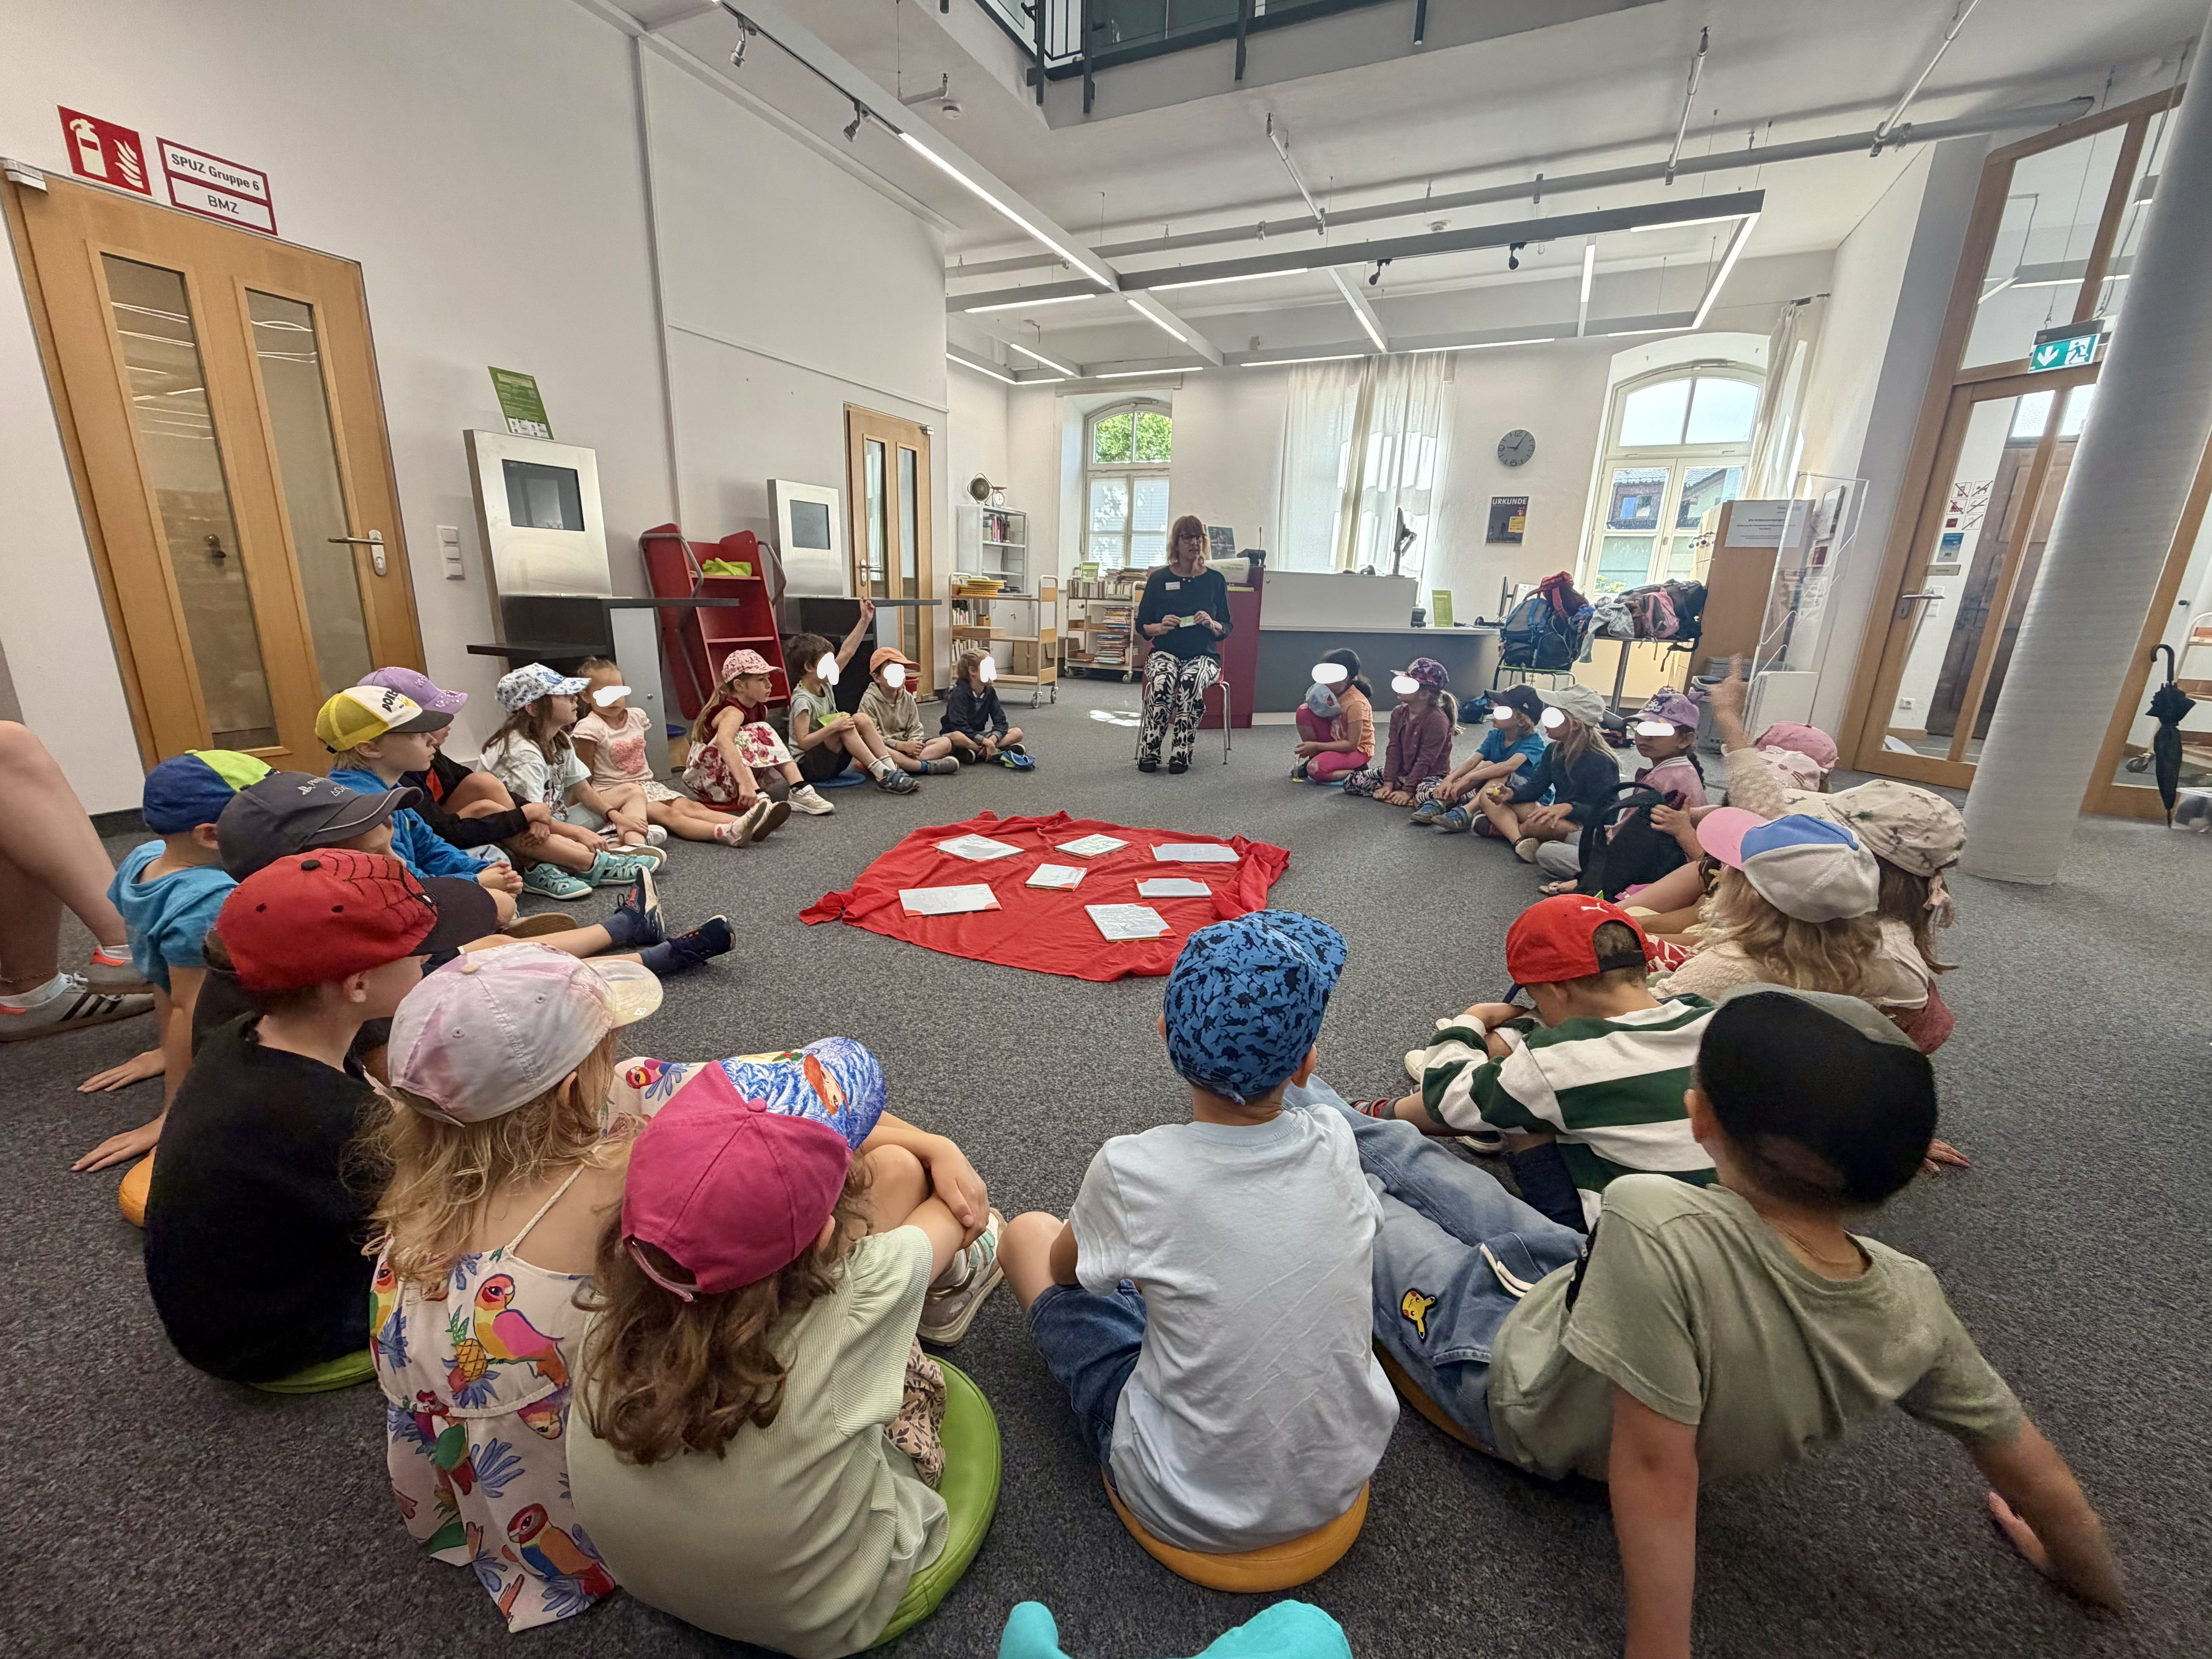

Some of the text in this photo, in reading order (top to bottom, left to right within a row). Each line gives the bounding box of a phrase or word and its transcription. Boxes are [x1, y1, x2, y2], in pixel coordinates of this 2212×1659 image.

[171, 153, 259, 191] SPUZ Gruppe 6
[208, 194, 239, 214] BMZ
